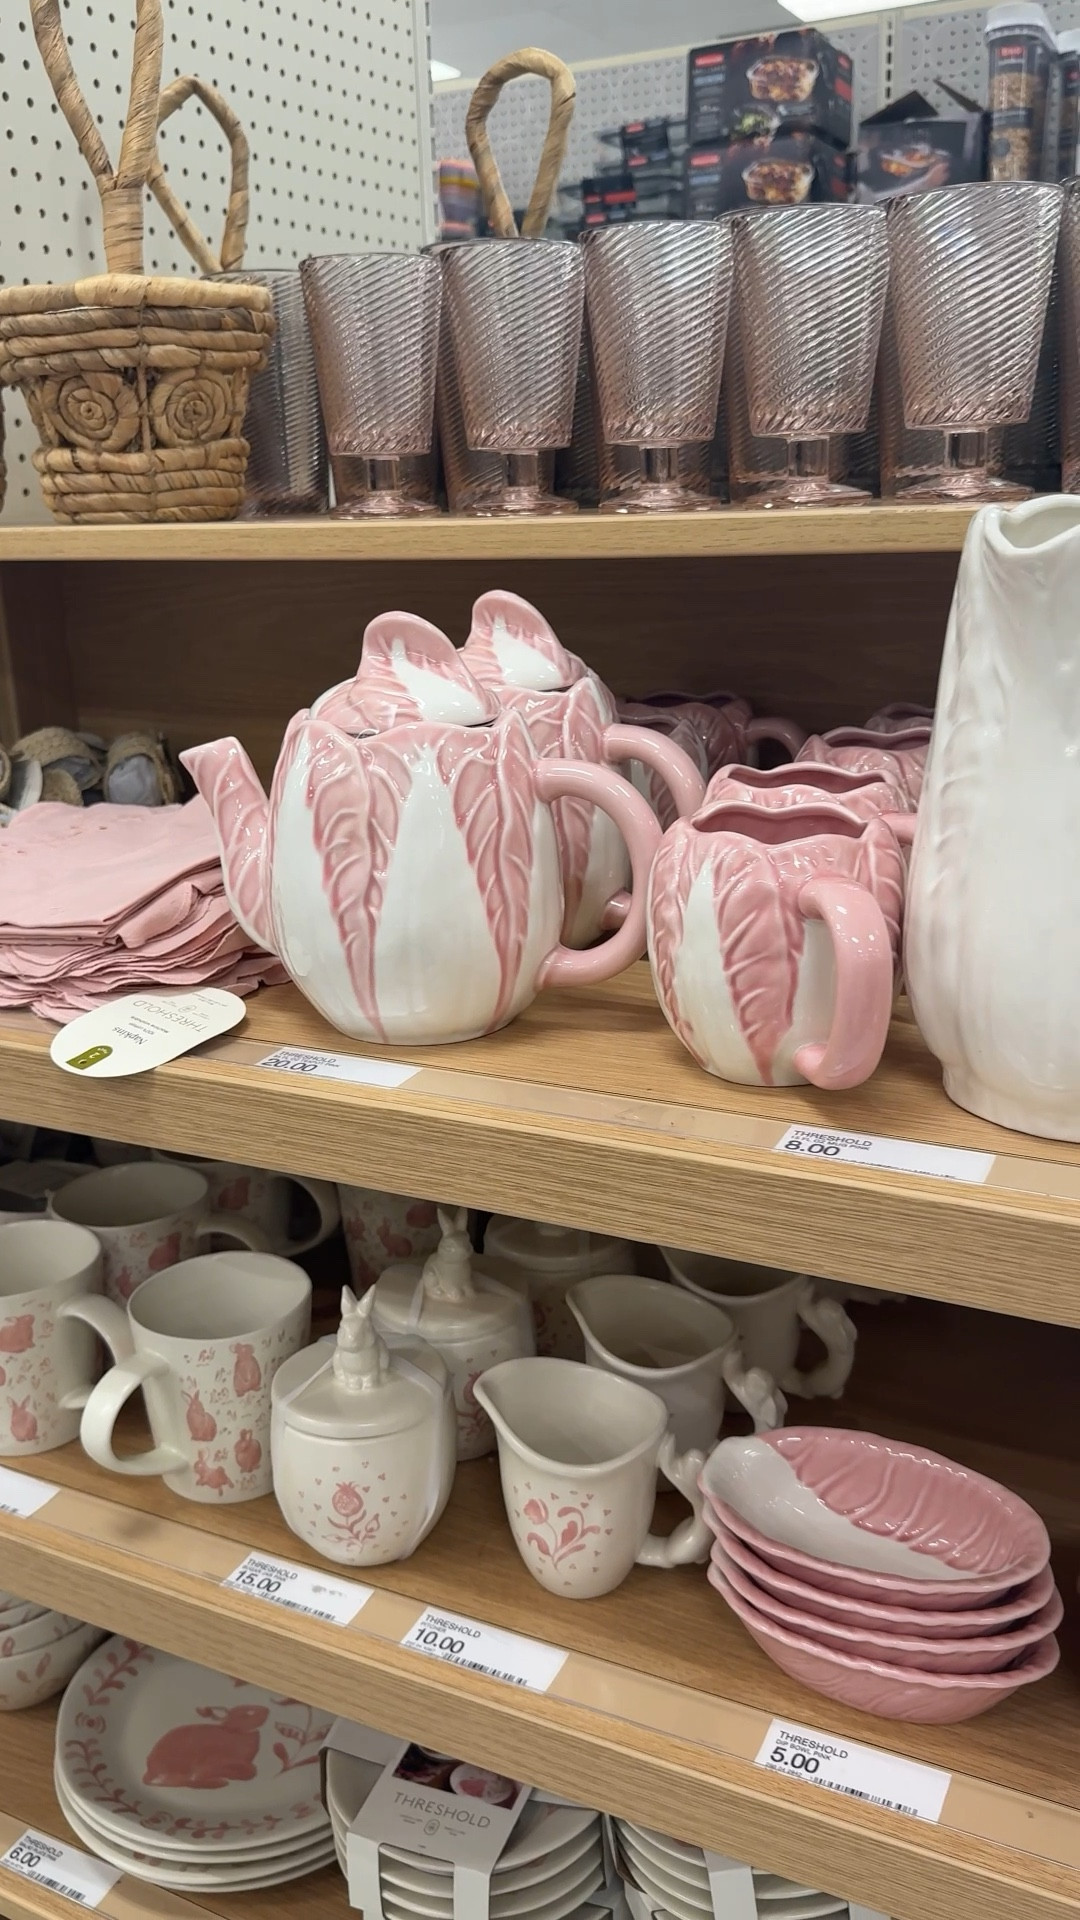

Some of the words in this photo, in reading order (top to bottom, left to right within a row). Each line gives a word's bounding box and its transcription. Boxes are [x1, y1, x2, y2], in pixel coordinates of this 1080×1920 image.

[132, 1000, 208, 1032] THRESHOLD
[112, 1026, 148, 1045] Napkins
[262, 1058, 318, 1072] 20.00
[279, 1051, 337, 1063] THRESHOLD
[784, 1140, 840, 1157] 8.00
[793, 1130, 873, 1147] THRESHOLD
[246, 1558, 299, 1580] THRESHOLD
[235, 1570, 282, 1593] 15.00
[420, 1621, 447, 1634] PITCHER
[425, 1614, 482, 1639] THRESHOLD
[415, 1628, 465, 1654] 10.00
[775, 1738, 789, 1747] DIP
[789, 1742, 812, 1756] BOWL
[812, 1750, 832, 1761] PINK
[779, 1730, 849, 1759] THRESHOLD
[770, 1746, 820, 1774] 5.00
[394, 1792, 491, 1829] THRESHOLD
[9, 1847, 41, 1868] 6.00
[24, 1835, 64, 1858] THRESHOLD
